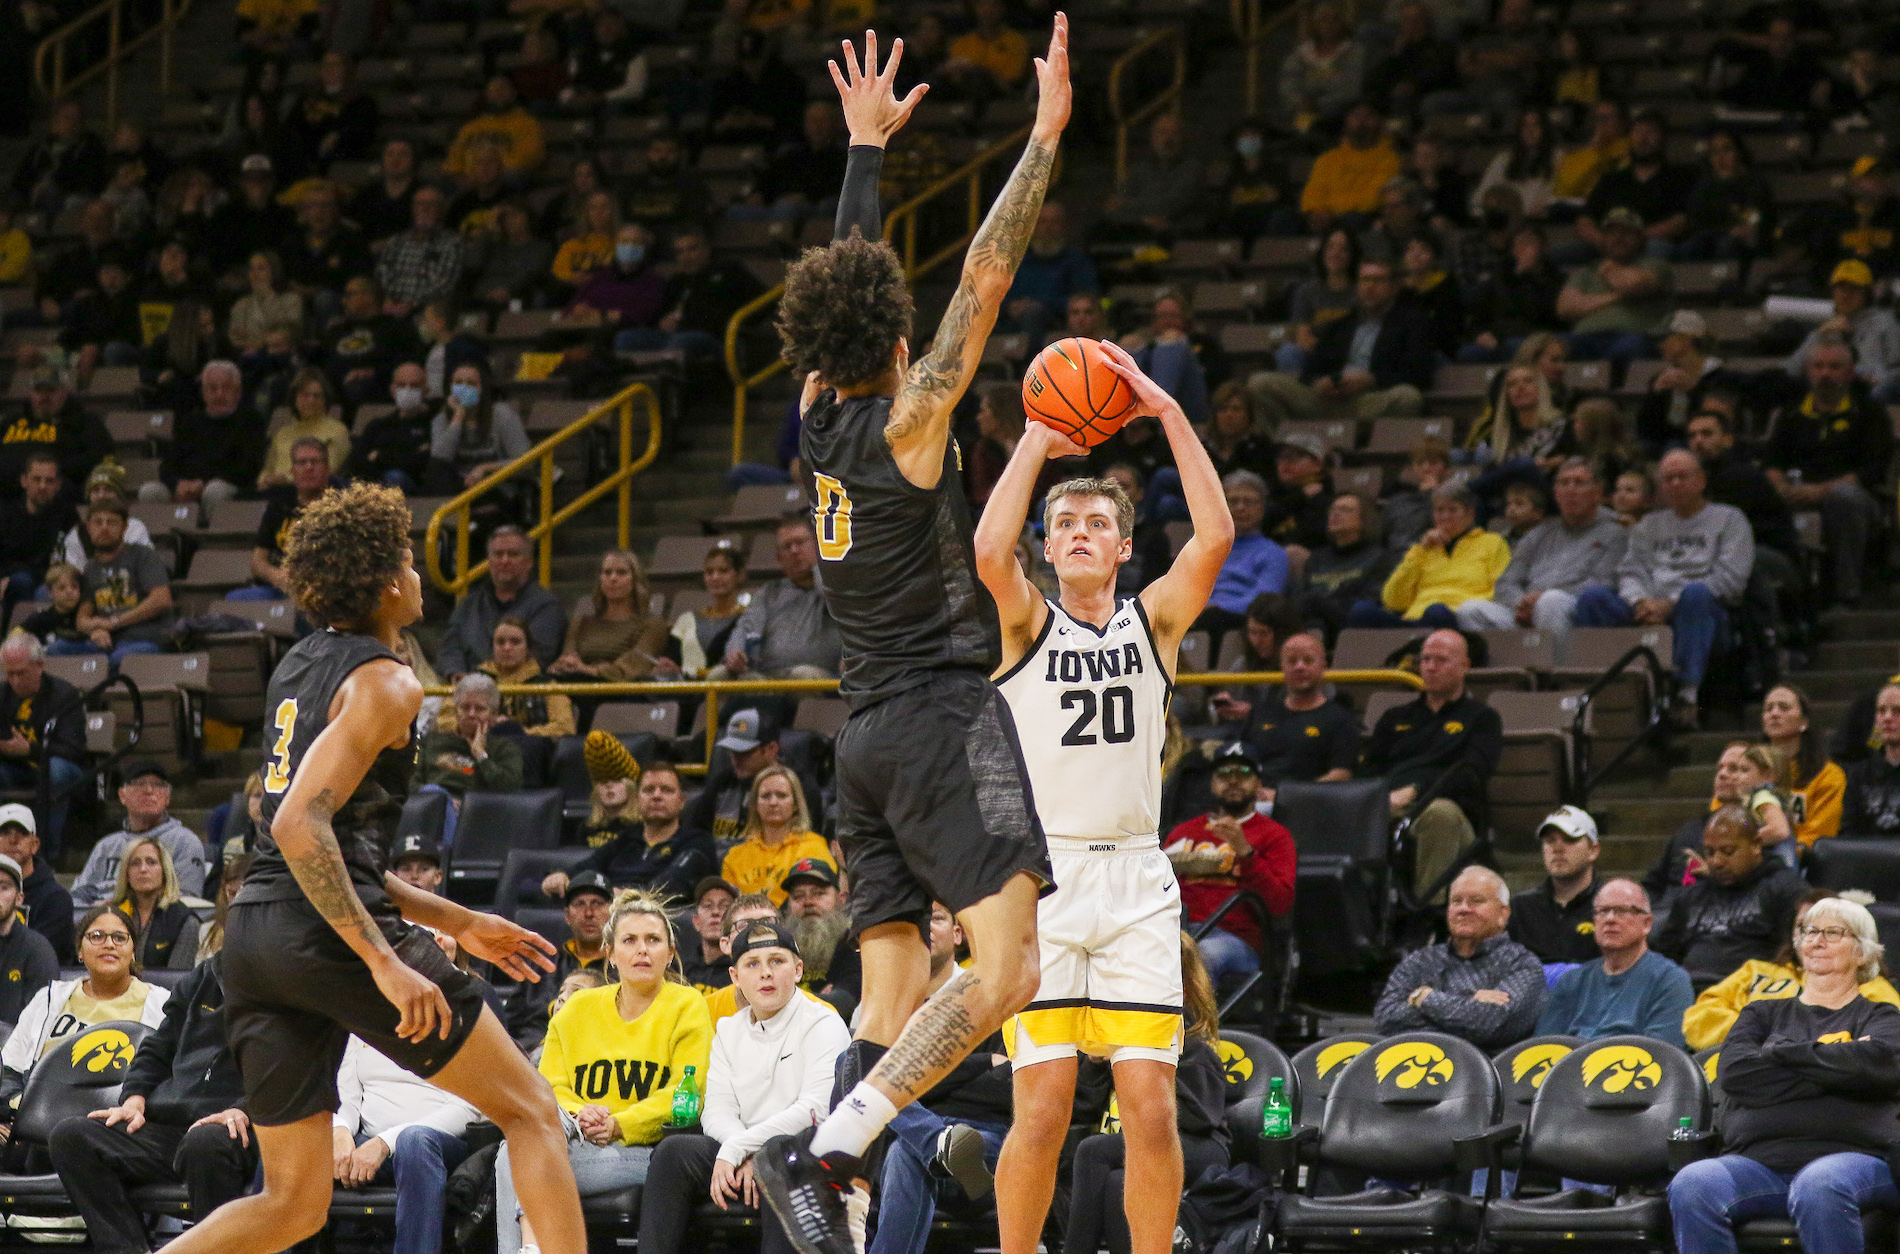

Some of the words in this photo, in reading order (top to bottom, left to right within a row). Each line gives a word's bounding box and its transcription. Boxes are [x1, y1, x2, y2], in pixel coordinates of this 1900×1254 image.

[813, 472, 853, 561] 0
[1109, 617, 1135, 633] BIG
[1045, 642, 1143, 682] IOWA
[1060, 685, 1135, 747] 20
[264, 697, 298, 793] 3
[1088, 844, 1116, 852] HAWKS
